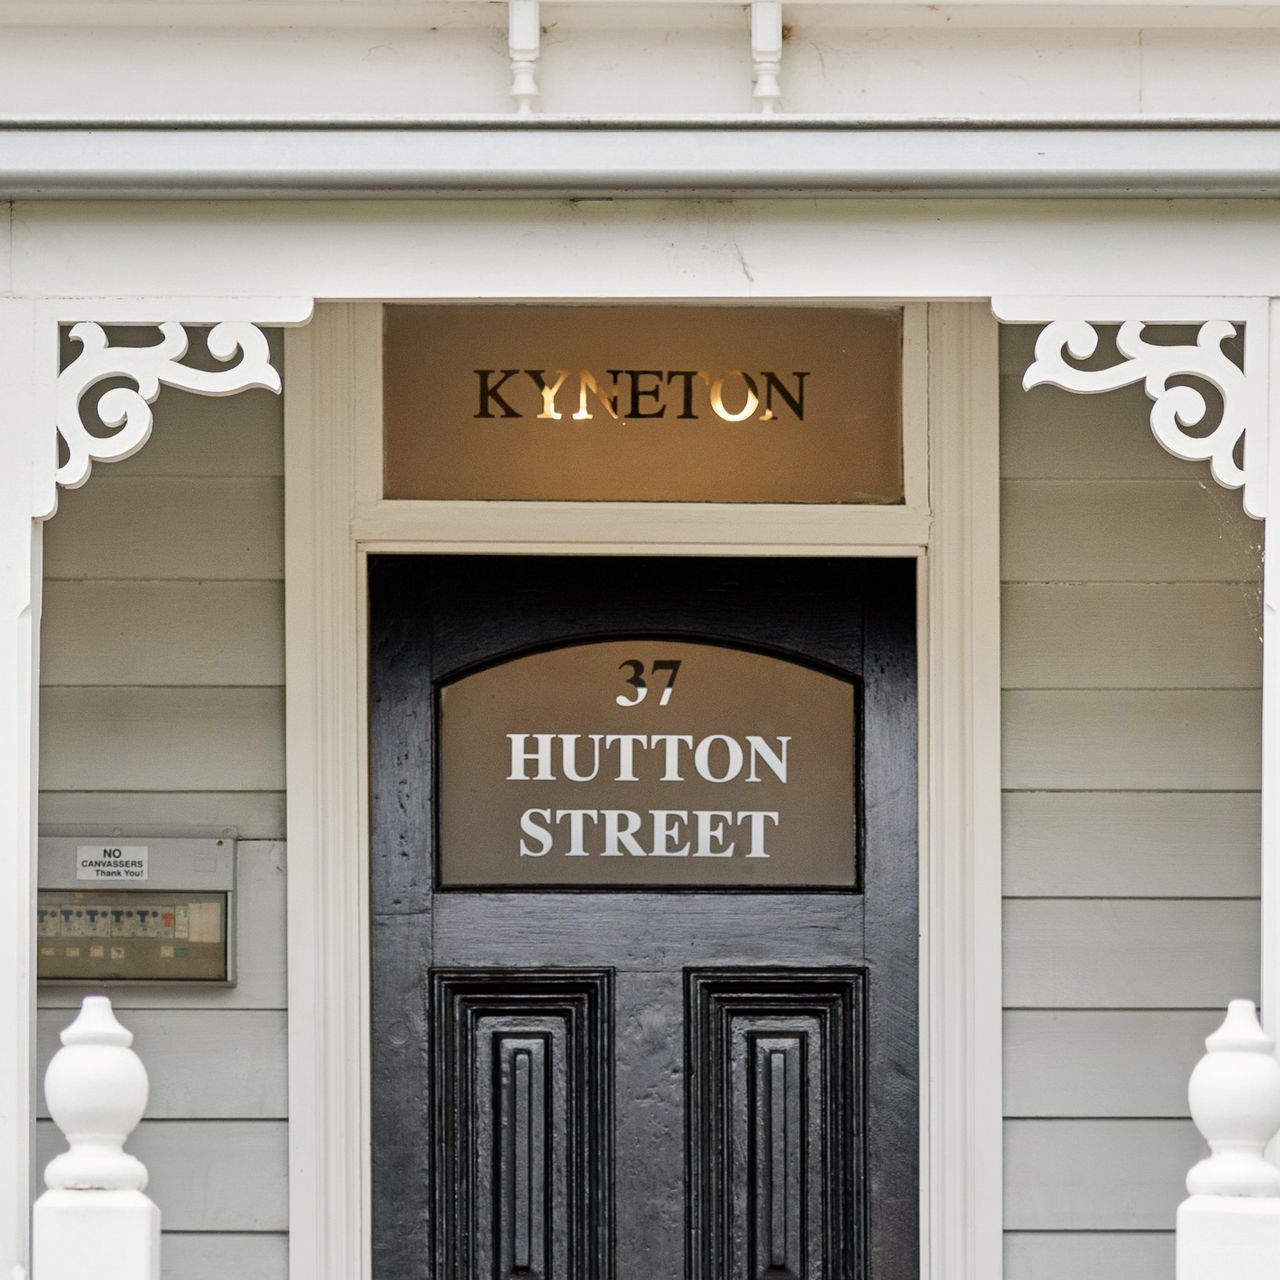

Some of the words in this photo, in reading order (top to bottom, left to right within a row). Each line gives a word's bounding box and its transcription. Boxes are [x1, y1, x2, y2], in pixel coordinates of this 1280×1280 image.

[472, 368, 811, 422] KYNETON
[615, 658, 683, 708] 37
[505, 733, 792, 784] HUTTON
[103, 848, 122, 859] NO
[519, 807, 780, 859] STREET
[80, 860, 144, 868] CANVASSERS
[95, 869, 122, 877] Thank
[124, 869, 144, 877] You!
